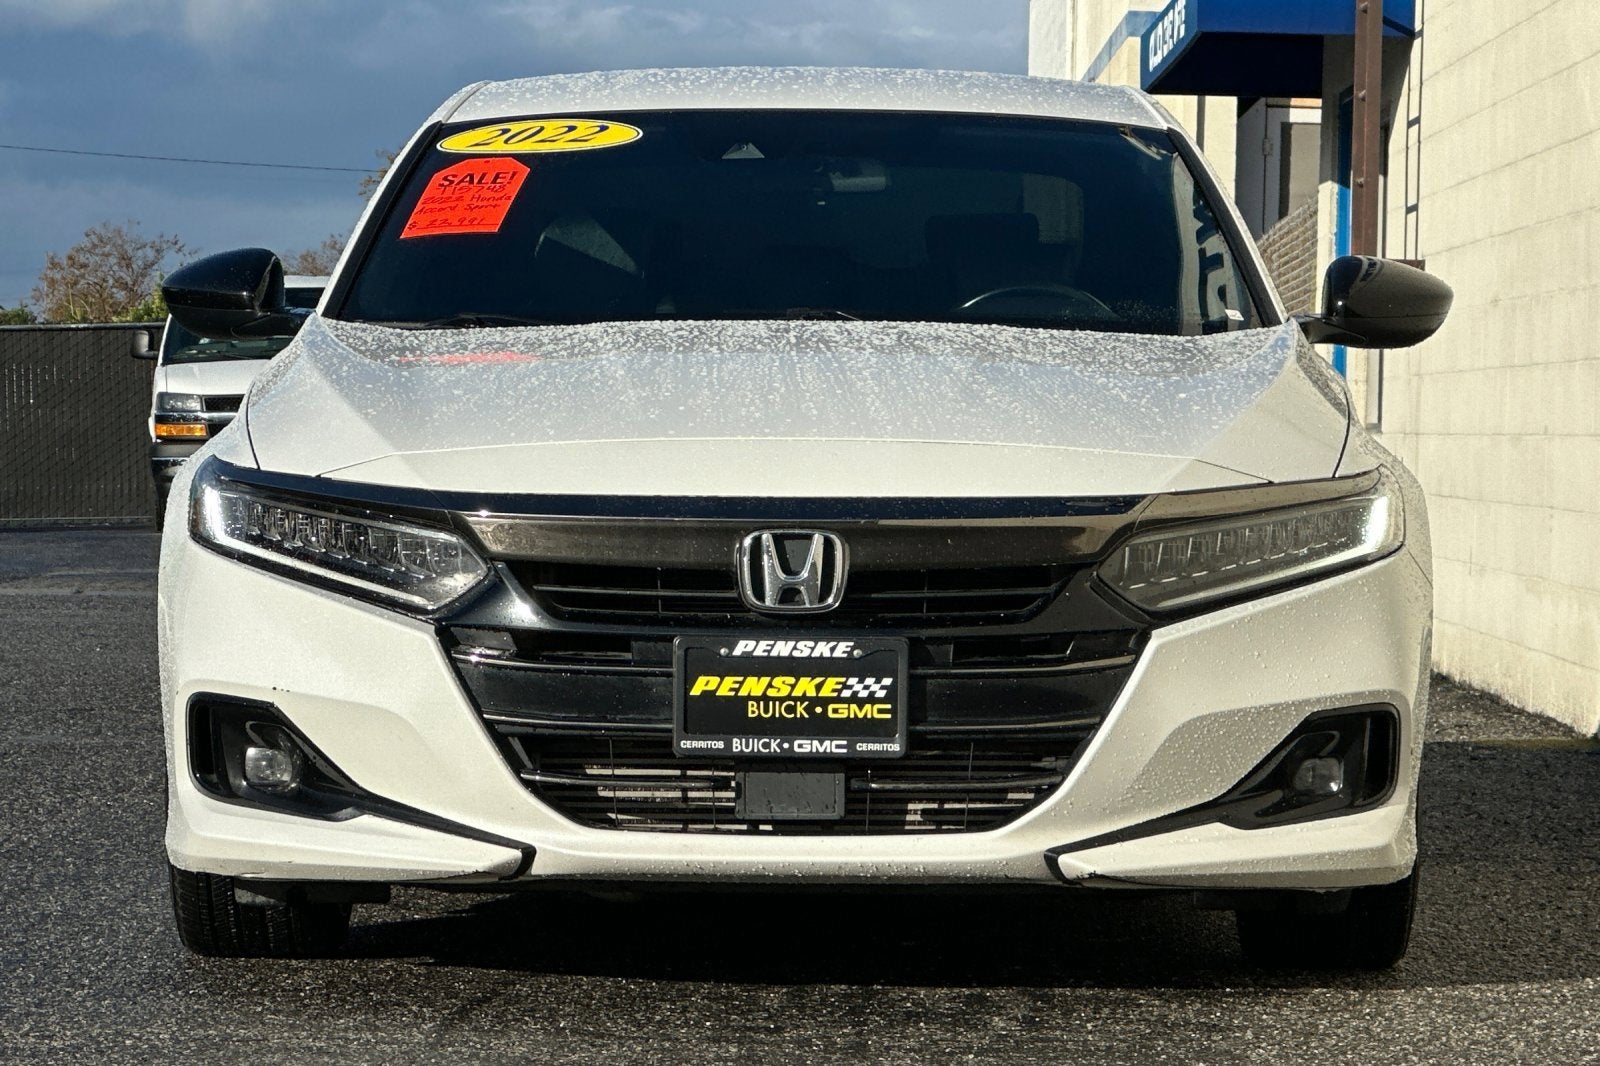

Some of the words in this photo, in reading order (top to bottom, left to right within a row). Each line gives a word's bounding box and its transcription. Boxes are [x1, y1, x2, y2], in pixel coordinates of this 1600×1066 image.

[465, 124, 610, 147] 2022
[438, 171, 518, 187] SALE!
[469, 194, 512, 203] Honda
[414, 204, 458, 215] Accord
[464, 203, 500, 212] Sport
[732, 640, 854, 658] PENSKE
[689, 676, 847, 697] PENSKE
[748, 701, 809, 718] BUICK
[827, 703, 892, 719] GMC
[680, 740, 724, 749] CERRITOS
[732, 738, 781, 753] BUICK
[793, 739, 848, 753] GMC
[856, 742, 900, 751] CERRITOS
